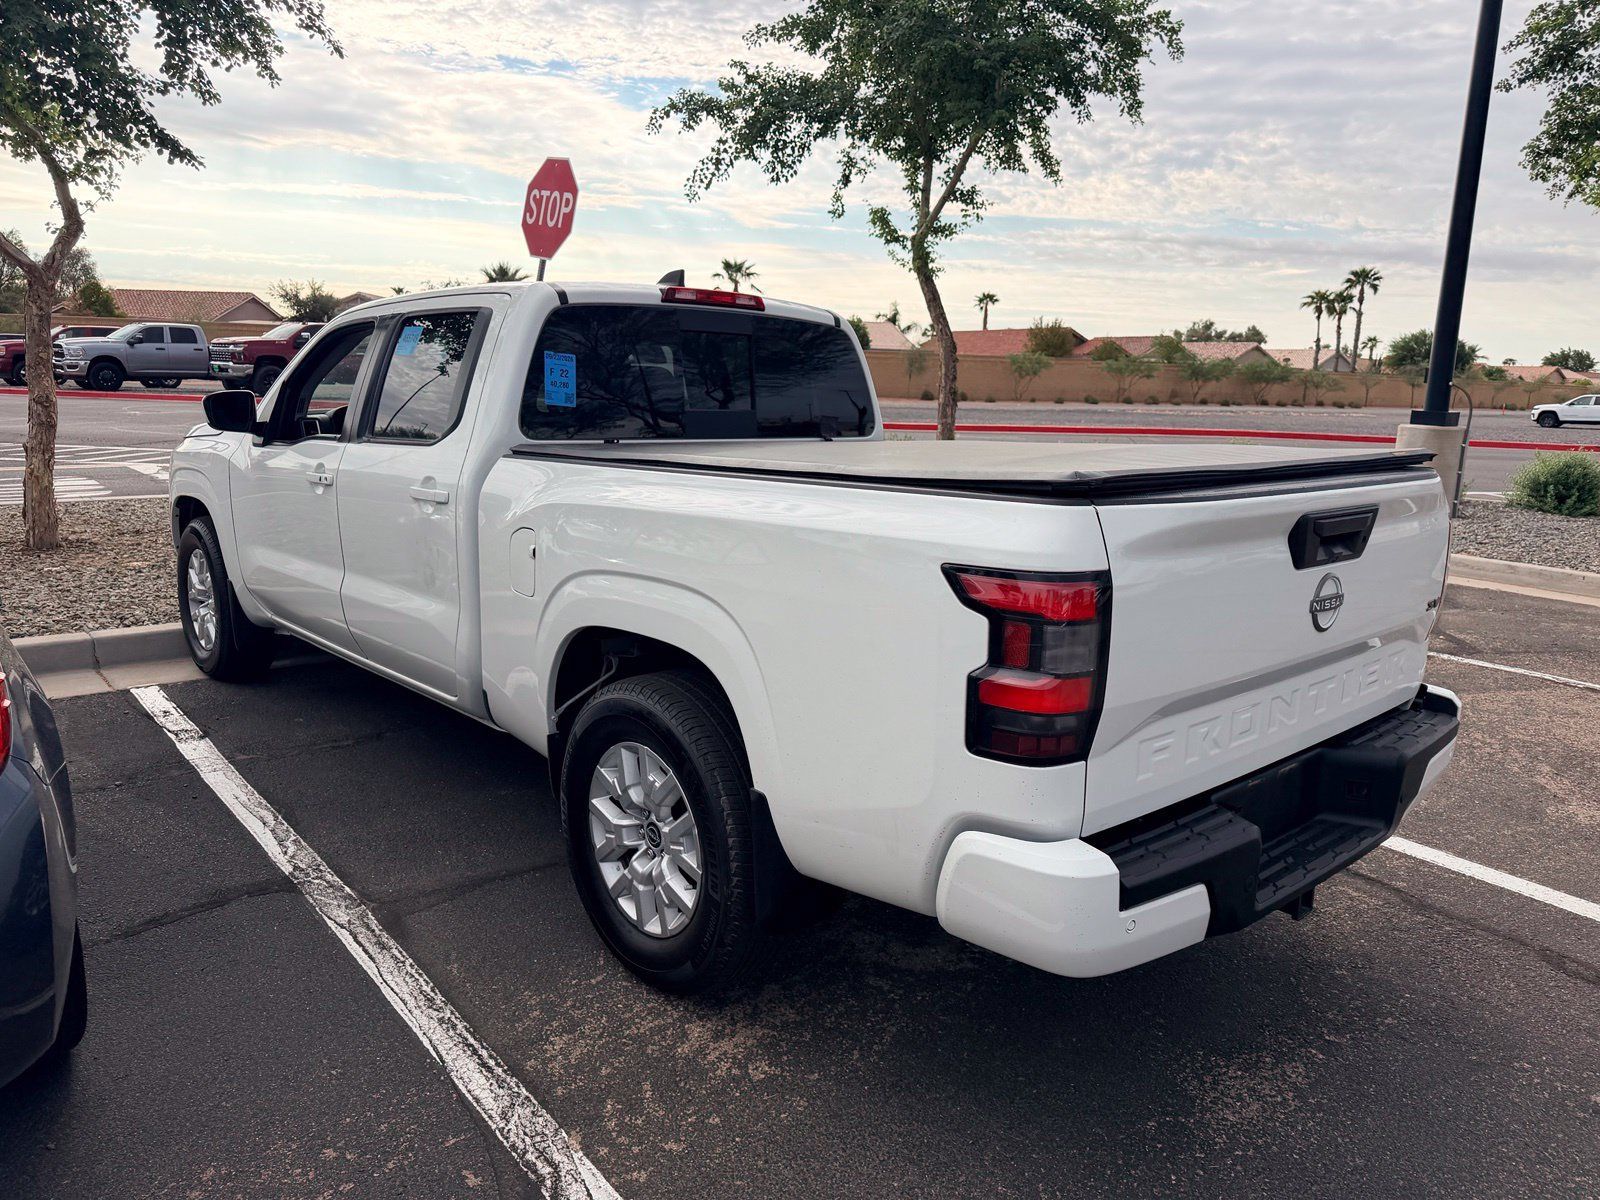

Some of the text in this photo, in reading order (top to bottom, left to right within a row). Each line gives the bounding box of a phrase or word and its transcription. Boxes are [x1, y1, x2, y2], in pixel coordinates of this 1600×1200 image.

[526, 188, 573, 228] STOP
[550, 368, 569, 378] F 22
[1136, 648, 1408, 782] FRONTIER
